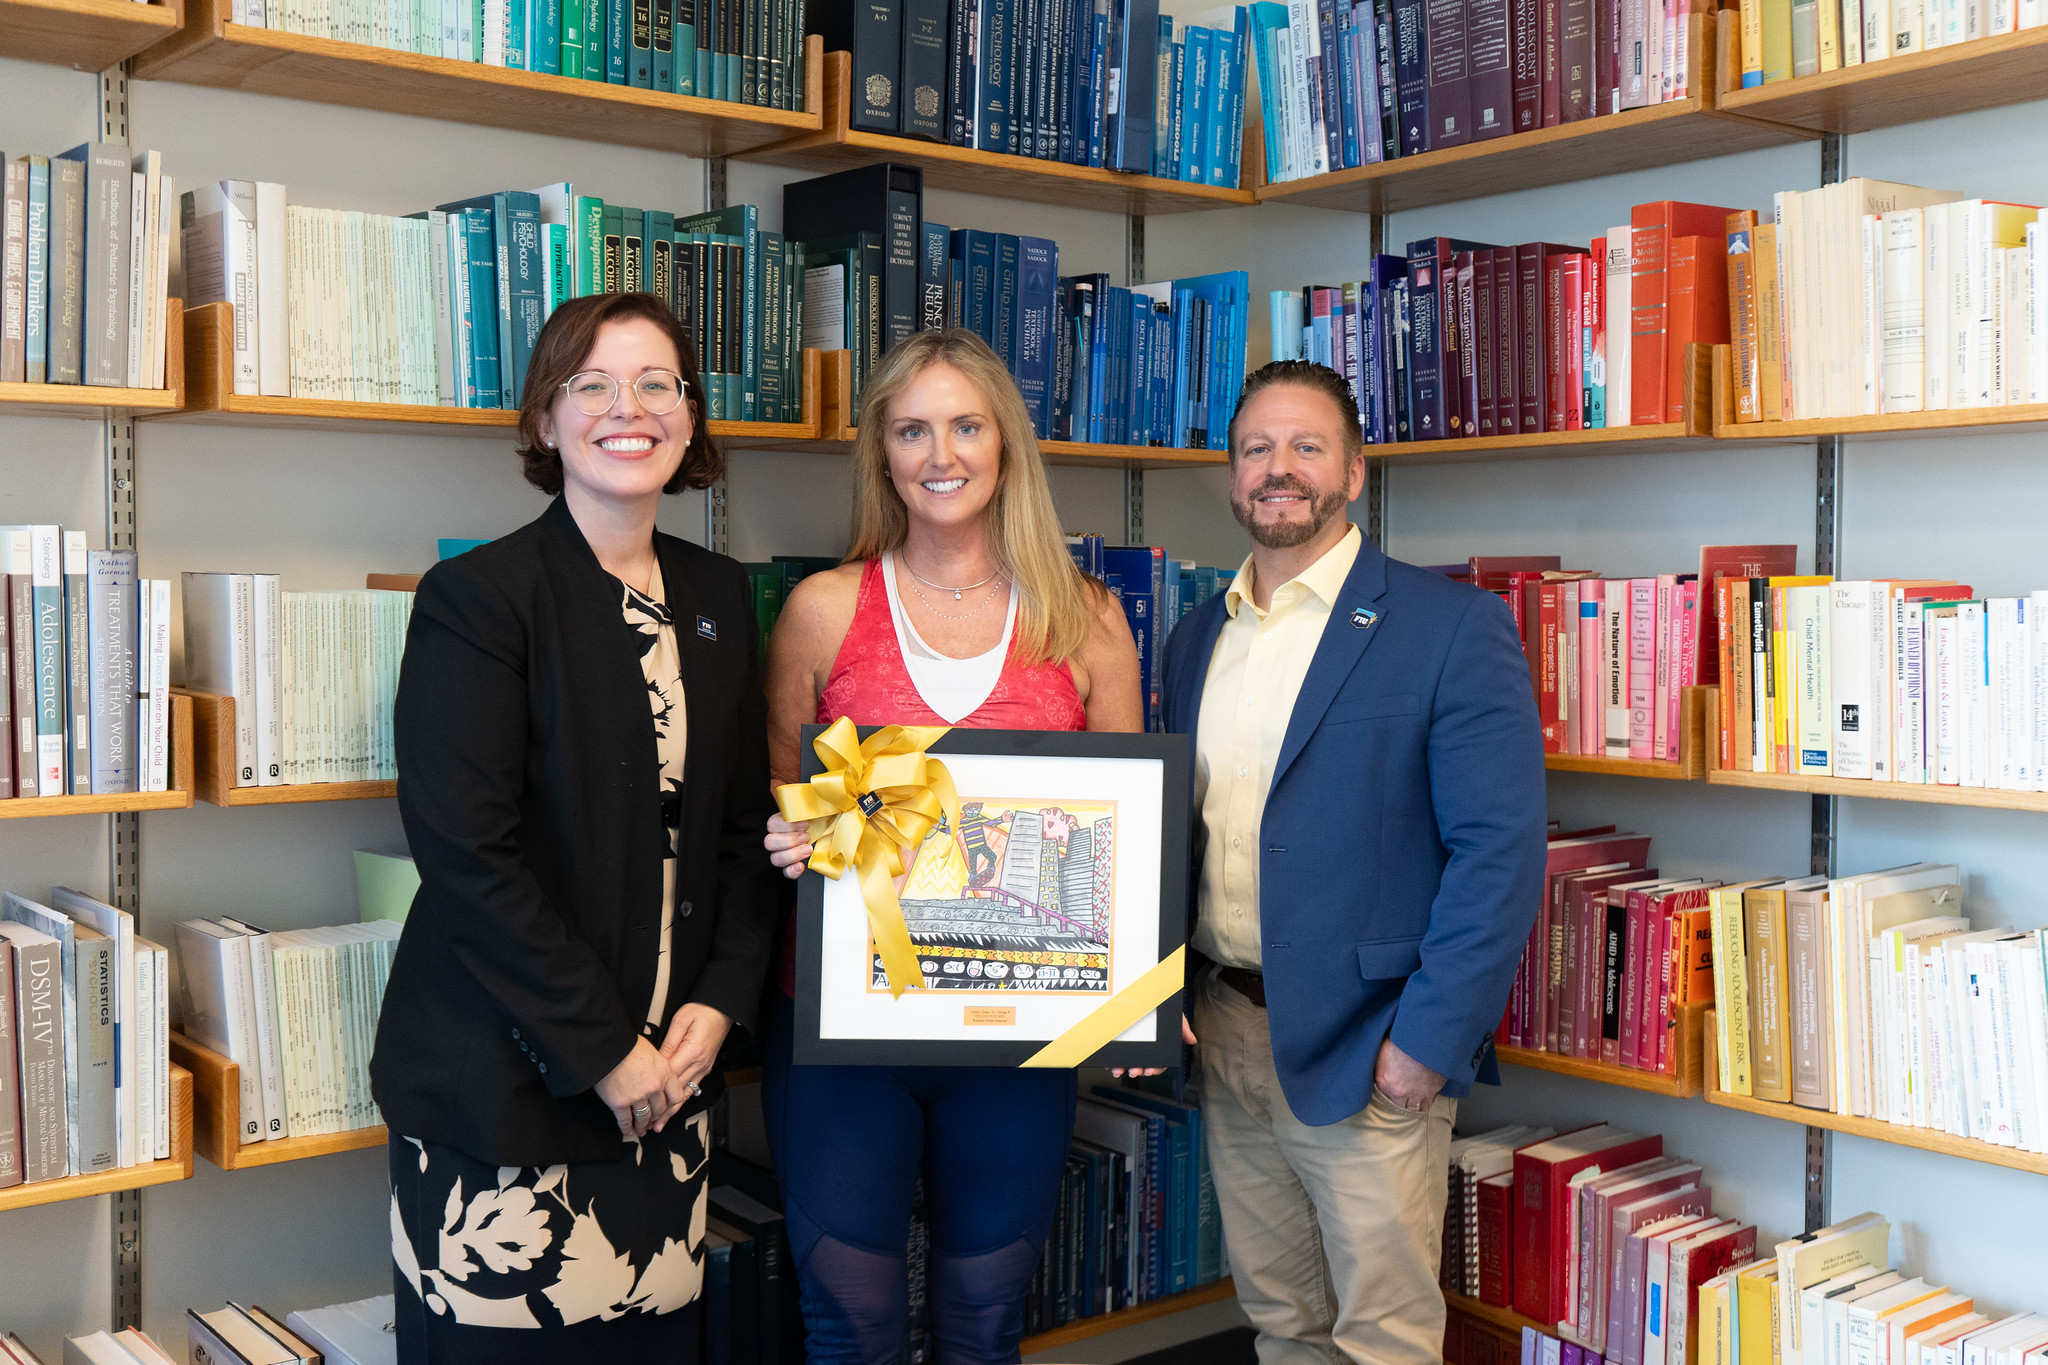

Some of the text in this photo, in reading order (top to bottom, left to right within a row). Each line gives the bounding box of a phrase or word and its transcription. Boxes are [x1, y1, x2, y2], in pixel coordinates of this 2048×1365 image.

[992, 14, 1002, 88] PSYCHOLOGY
[1028, 28, 1032, 36] IN
[1546, 3, 1555, 81] Genetics of Alcoholism
[1291, 3, 1307, 125] ICDL Clinical Practice Guidelines
[1325, 44, 1333, 71] Abnormal
[1177, 82, 1181, 93] in
[1327, 90, 1336, 123] Psychology
[866, 109, 890, 117] OXFORD
[914, 120, 937, 128] OXFORD
[96, 157, 125, 167] ROBERTS
[7, 199, 23, 239] CHILDREN,
[235, 193, 254, 201] Wilson
[6, 241, 22, 278] FAMILIES,
[28, 201, 45, 336] Problem Drinkers
[106, 180, 119, 341] Handbook of Pediatric Psychology
[461, 236, 469, 263] COACHING
[518, 222, 528, 280] PSYCHOLOGY
[590, 207, 602, 295] Developmental
[749, 245, 755, 254] TO
[6, 289, 21, 340] GOVERNMENT
[236, 274, 246, 349] RELAPSE PREVENTION
[463, 282, 471, 313] BASKETBALL
[772, 333, 778, 344] OF
[1345, 314, 1356, 334] WHAT
[1414, 295, 1422, 354] PSYCHIATRY
[1447, 323, 1457, 352] Manual
[1460, 286, 1473, 377] Publication Manual
[1526, 283, 1534, 397] HANDBOOK OF PARENTING
[1583, 291, 1592, 372] fire child water child
[1736, 261, 1751, 388] SERIOUS EMOTIONAL DISTURBANCE
[1346, 335, 1357, 361] WORKS
[1346, 363, 1357, 377] FOR
[42, 536, 52, 579] Steinberg
[1741, 564, 1762, 577] THE
[1354, 615, 1368, 624] FIU
[1718, 588, 1726, 619] Positivity
[1753, 601, 1764, 652] Eunethydis
[1547, 623, 1555, 636] The
[41, 602, 58, 719] Adolescence
[96, 637, 105, 716] SECOND EDITION
[108, 590, 122, 763] TREATMENTS THAT WORK
[125, 660, 133, 691] Guide
[1547, 638, 1555, 670] Energetic
[1612, 611, 1620, 705] The Nature of Emotion
[1671, 619, 1680, 699] CHILDREN'S THINKING
[1805, 618, 1815, 700] Child Mental Health
[1906, 627, 1921, 699] LEARNED OPTIMISM
[125, 693, 132, 704] to
[154, 624, 165, 766] Making Divorce Easier on Your Child
[1939, 627, 1951, 739] Eats, Shoots & Leaves
[1841, 708, 1859, 722] 14th
[138, 961, 148, 990] Vaillant
[1554, 925, 1563, 985] LITIGATING
[1606, 930, 1618, 1015] ADHD in Adolescents
[1661, 949, 1670, 982] ADHD
[99, 950, 109, 1026] STATISTICS
[1660, 995, 1668, 1016] me
[1728, 916, 1745, 1064] REDUCING ADOLESCENT RISK
[37, 1061, 49, 1177] MANUAL OF MENTAL DISORDERS
[46, 1059, 58, 1165] DIAGNOSTIC AND STATISTICAL
